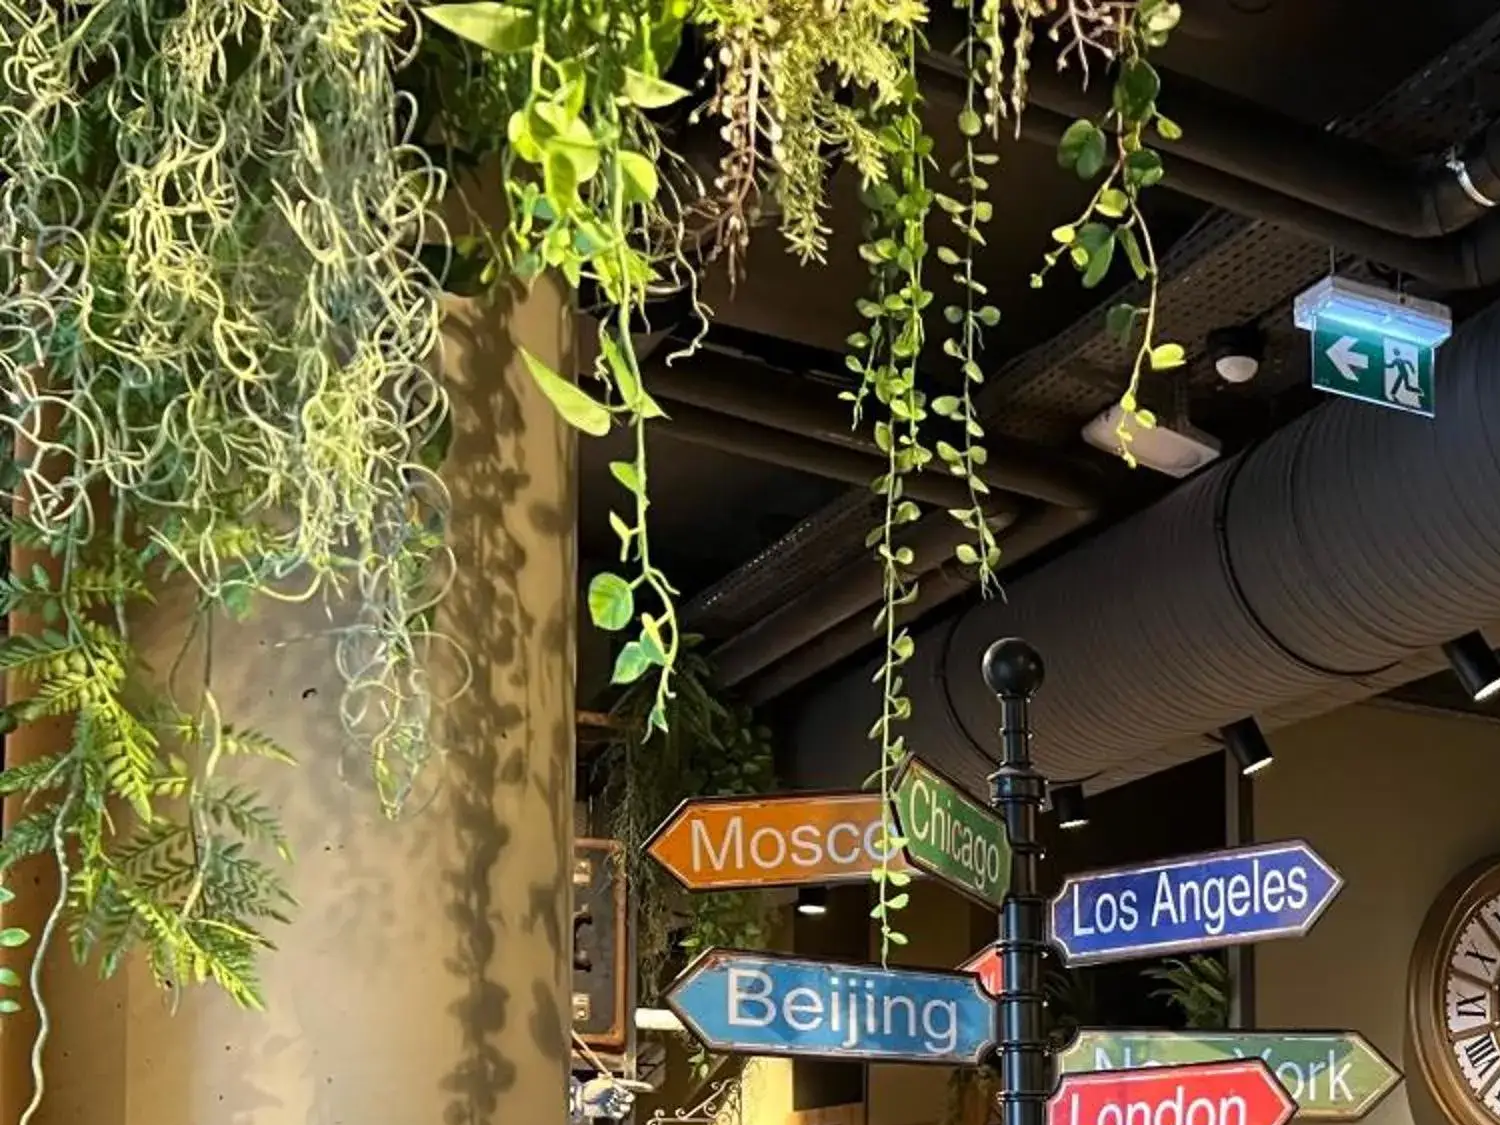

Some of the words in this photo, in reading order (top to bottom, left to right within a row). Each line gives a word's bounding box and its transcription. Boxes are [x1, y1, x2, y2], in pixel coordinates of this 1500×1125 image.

[690, 815, 899, 873] Mosco
[908, 779, 1001, 891] Chicago
[1072, 883, 1139, 937] Los
[1151, 859, 1309, 935] Angeles
[727, 966, 958, 1053] Beijing
[1233, 1047, 1355, 1102] ork
